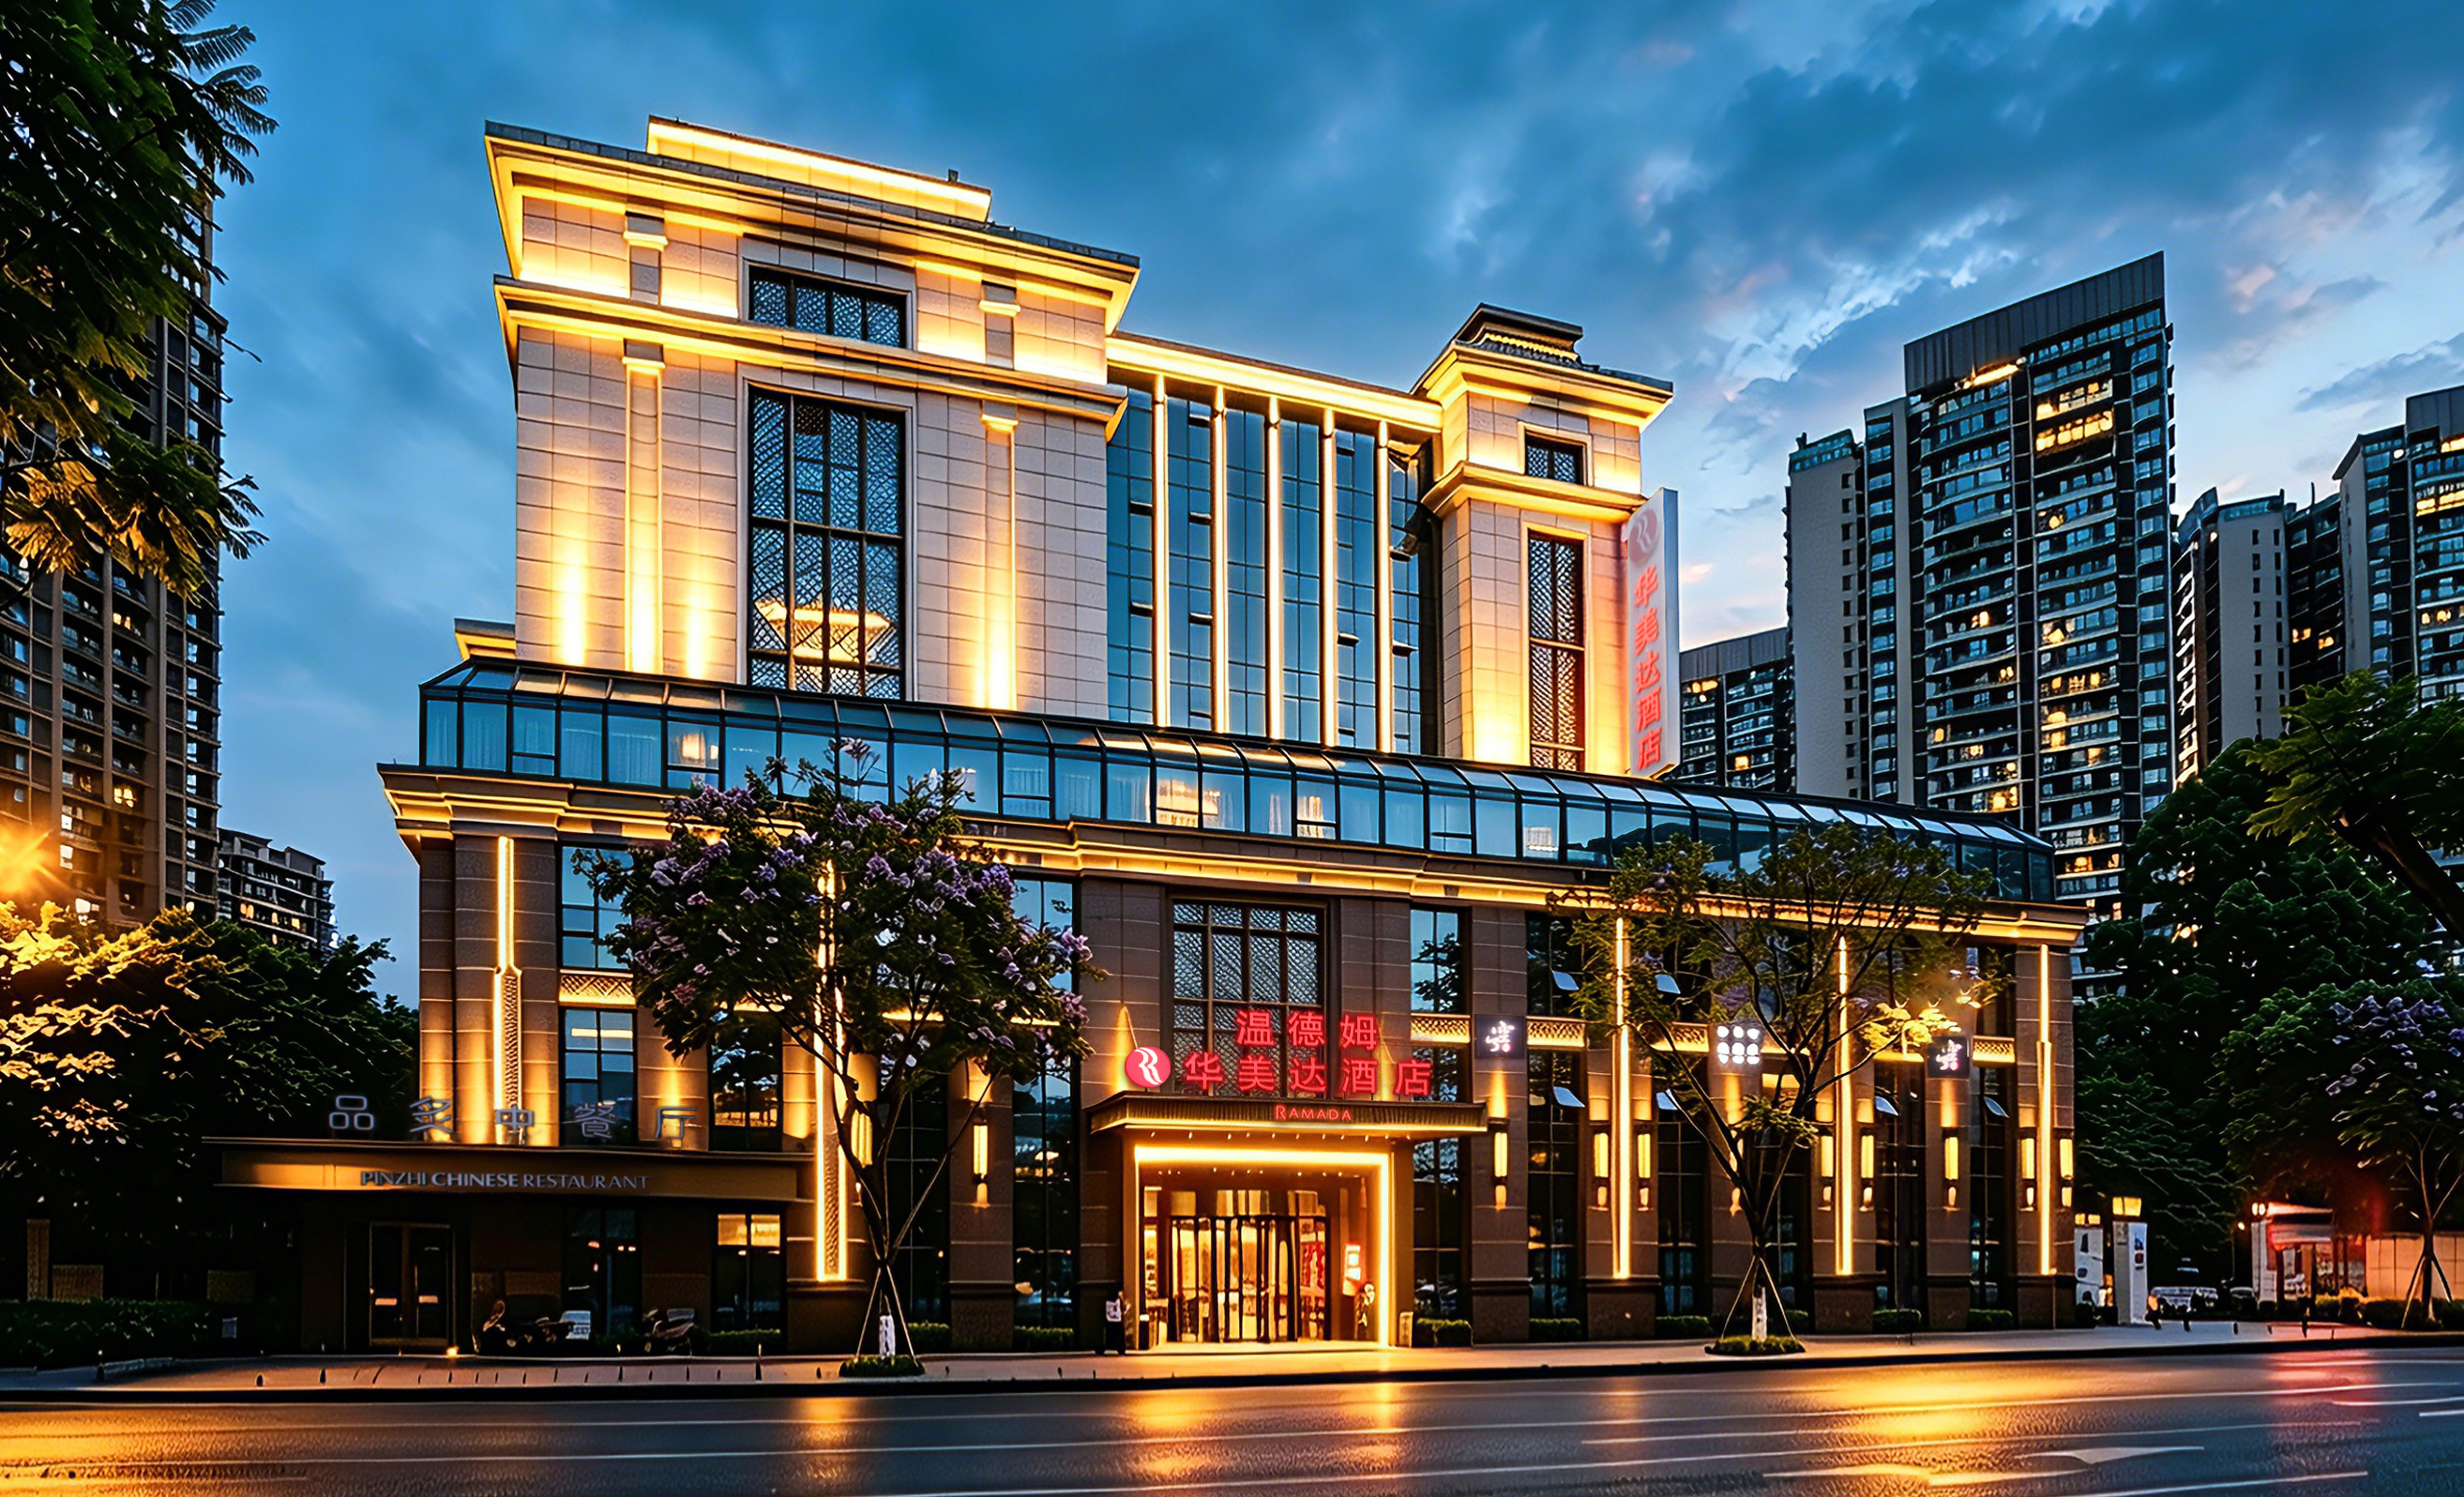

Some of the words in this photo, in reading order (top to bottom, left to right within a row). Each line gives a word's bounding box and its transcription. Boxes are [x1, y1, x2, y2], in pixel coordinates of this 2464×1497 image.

[1634, 566, 1661, 769] 华美达酒店
[1235, 1010, 1378, 1051] 温德姆
[1185, 1052, 1432, 1096] 华美达酒店
[329, 1095, 698, 1141] 品炙中餐厅
[1275, 1105, 1352, 1121] RAMADA
[361, 1172, 429, 1186] PINZHI
[431, 1172, 520, 1188] CHINESE
[523, 1173, 650, 1190] RESTAURANT
